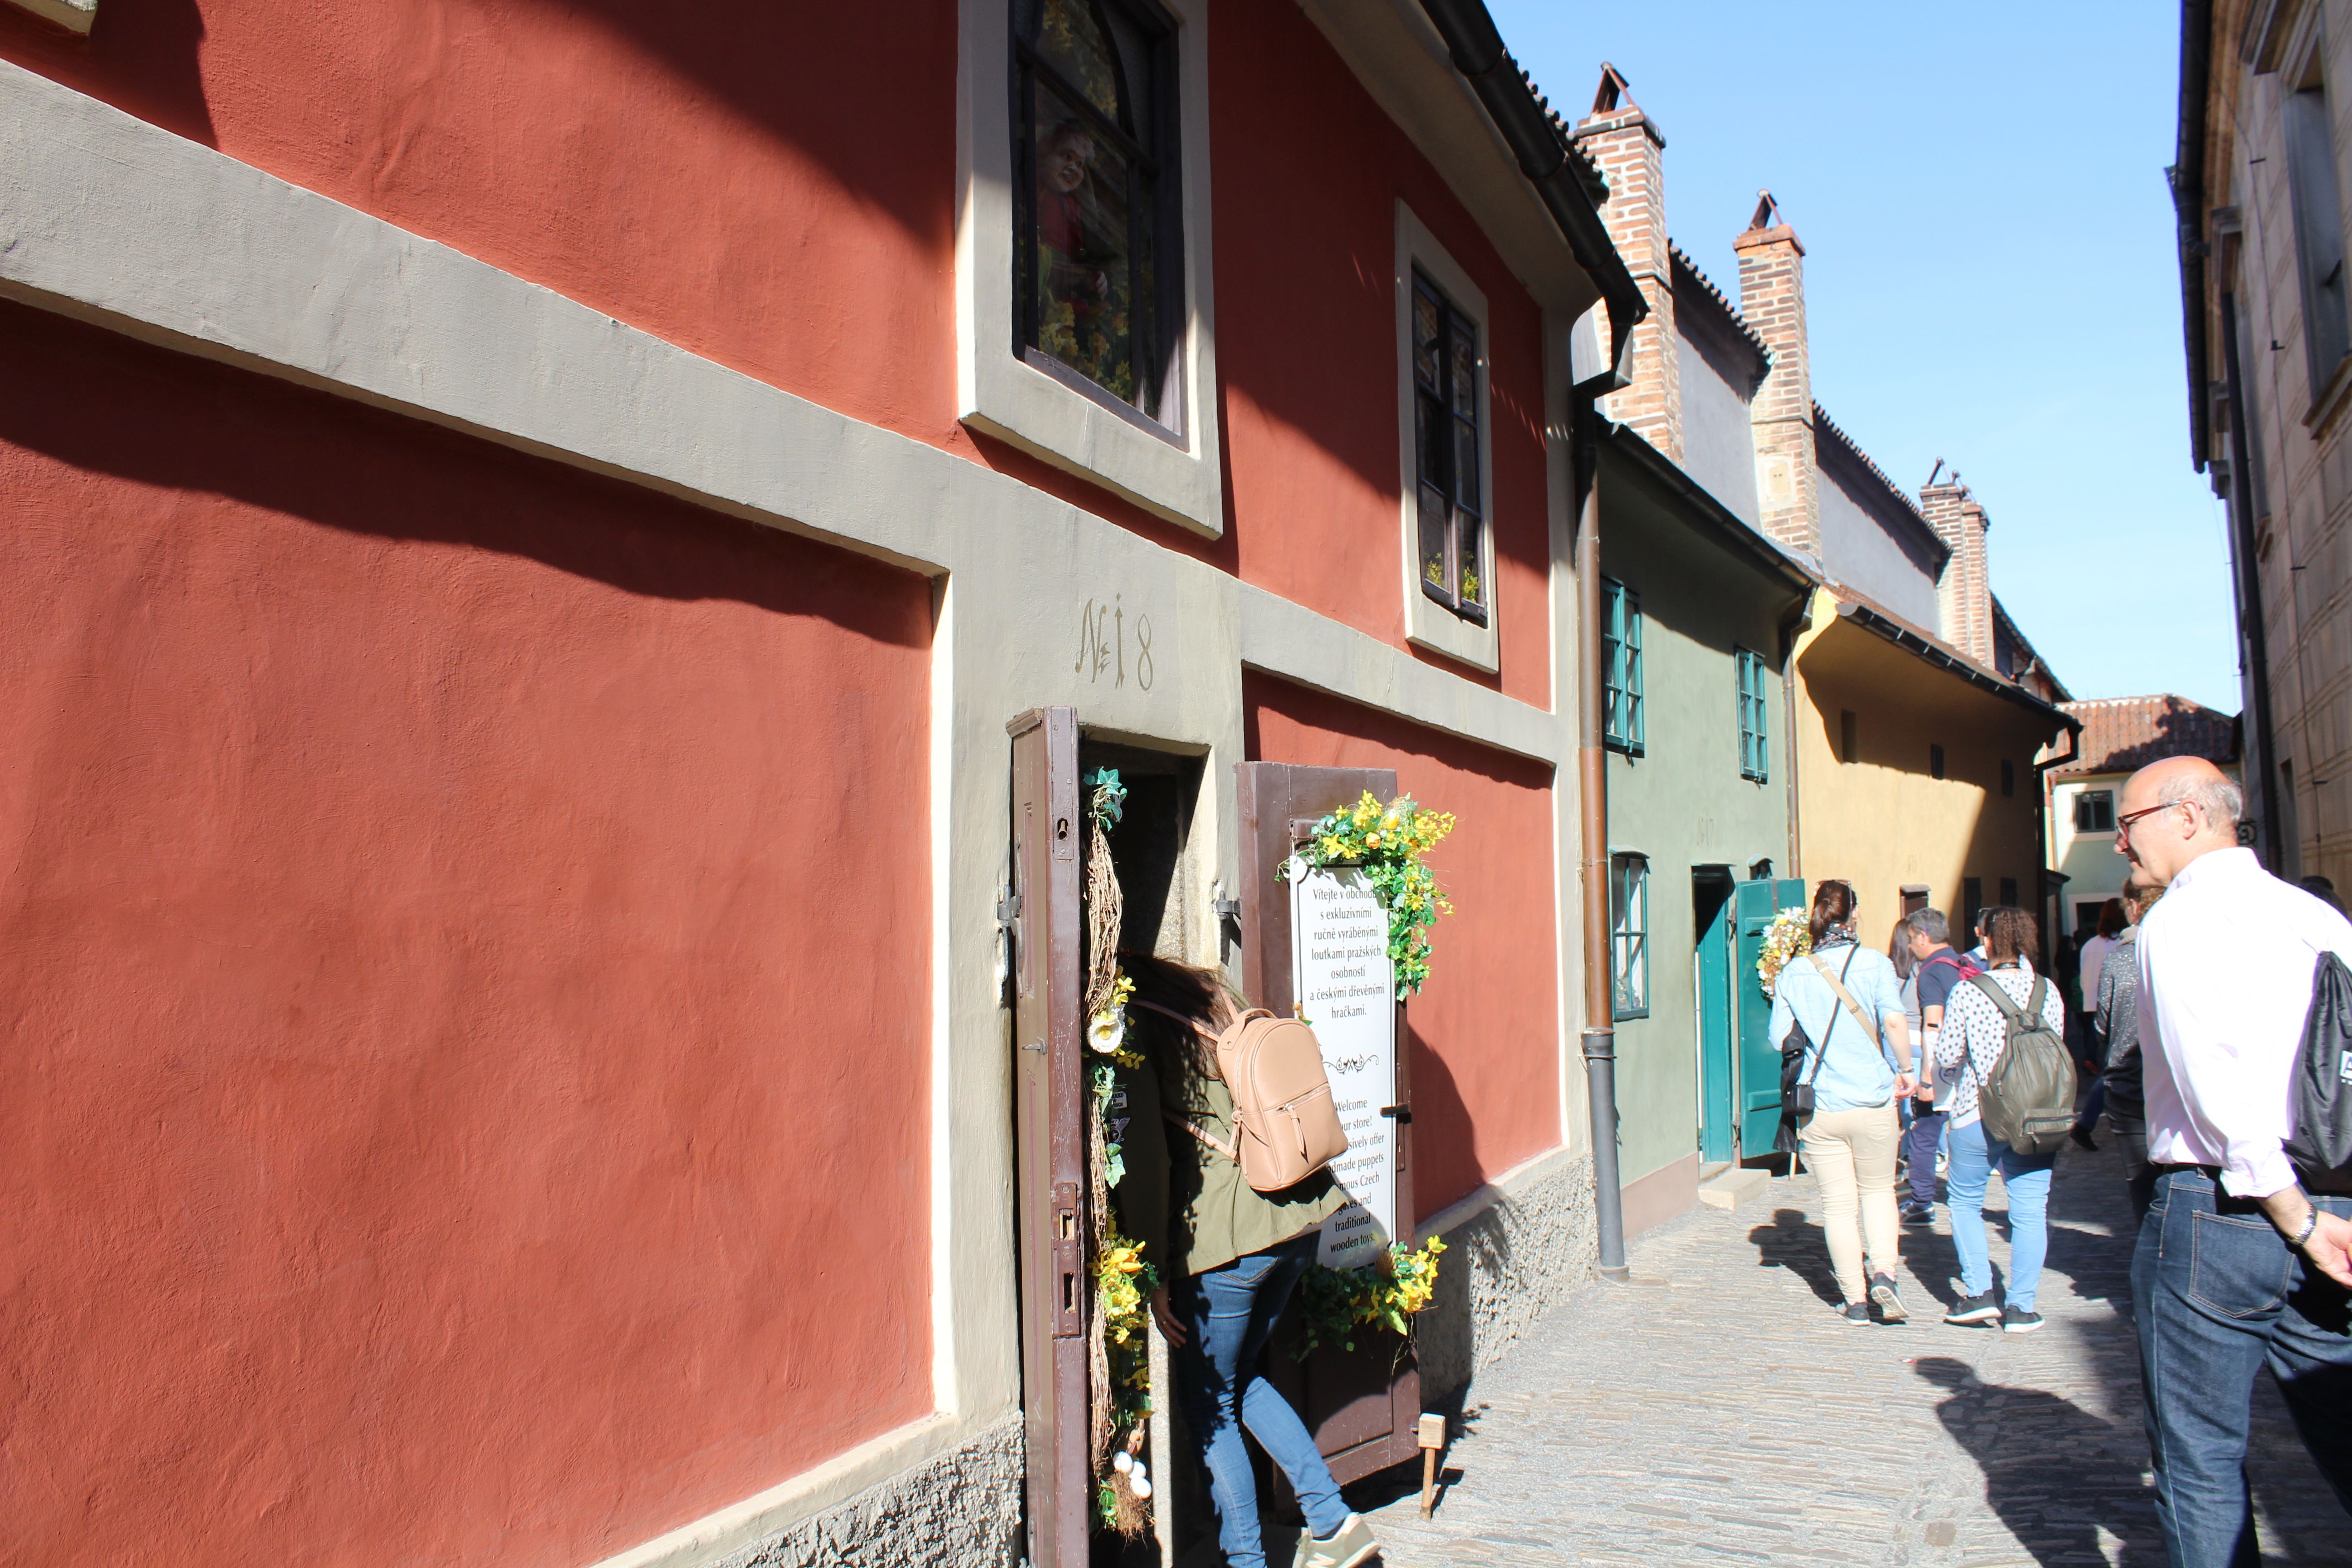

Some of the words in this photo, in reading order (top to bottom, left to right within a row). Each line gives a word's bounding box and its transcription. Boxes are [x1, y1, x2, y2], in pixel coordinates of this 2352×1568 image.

[1313, 888, 1338, 904] Vítejte
[1340, 892, 1344, 900] v
[1326, 907, 1372, 920] exkluzivními
[1314, 928, 1336, 940] ručně
[1338, 926, 1378, 943] vyráběnými
[1312, 946, 1345, 960] loutkami
[1348, 944, 1381, 962] pražských
[1331, 965, 1366, 979] osobností
[1317, 987, 1346, 1003] českými
[1348, 983, 1384, 1000] dřevěnými
[1332, 1004, 1367, 1019] hračkami.
[1335, 1099, 1367, 1112] Welcome
[1353, 1115, 1372, 1129] store!
[1348, 1135, 1368, 1151] sively
[1370, 1132, 1384, 1146] offer
[1358, 1152, 1384, 1172] puppets
[1339, 1179, 1358, 1191] mous
[1360, 1171, 1380, 1186] Czech
[1359, 1191, 1372, 1206] and
[1335, 1212, 1371, 1232] traditional
[1330, 1236, 1358, 1253] wooden
[1360, 1233, 1375, 1247] toys.
